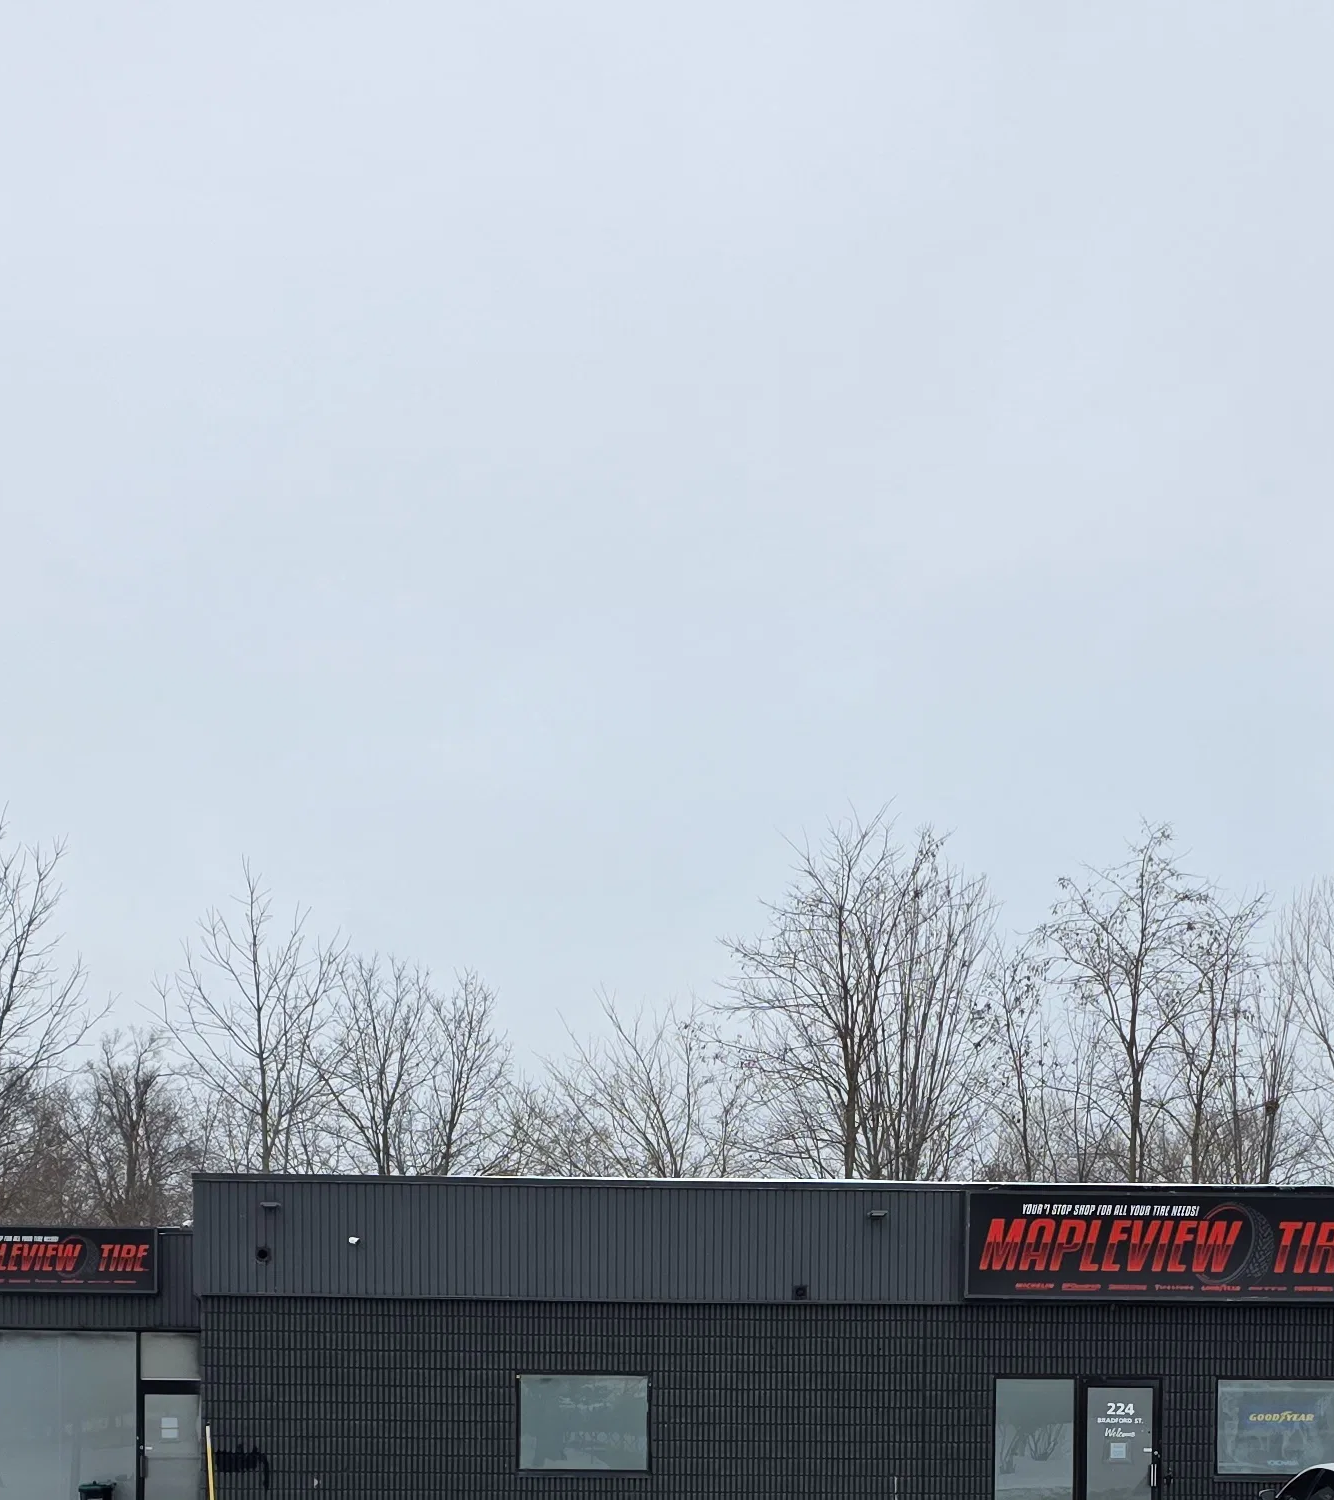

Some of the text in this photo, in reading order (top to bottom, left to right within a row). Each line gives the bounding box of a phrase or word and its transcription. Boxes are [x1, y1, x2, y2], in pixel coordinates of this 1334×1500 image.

[1051, 1204, 1073, 1215] STOP
[1073, 1204, 1096, 1215] SHOP
[1096, 1204, 1113, 1216] FOR
[1113, 1204, 1128, 1216] ALL
[1129, 1205, 1151, 1216] YOUR
[1152, 1205, 1171, 1216] TIRE
[1171, 1205, 1200, 1217] NEEDS!
[979, 1219, 1242, 1272] MAPLEVIEW
[98, 1244, 149, 1272] TIRE
[1106, 1402, 1135, 1415] 224
[1249, 1411, 1315, 1422] GOODYEAR
